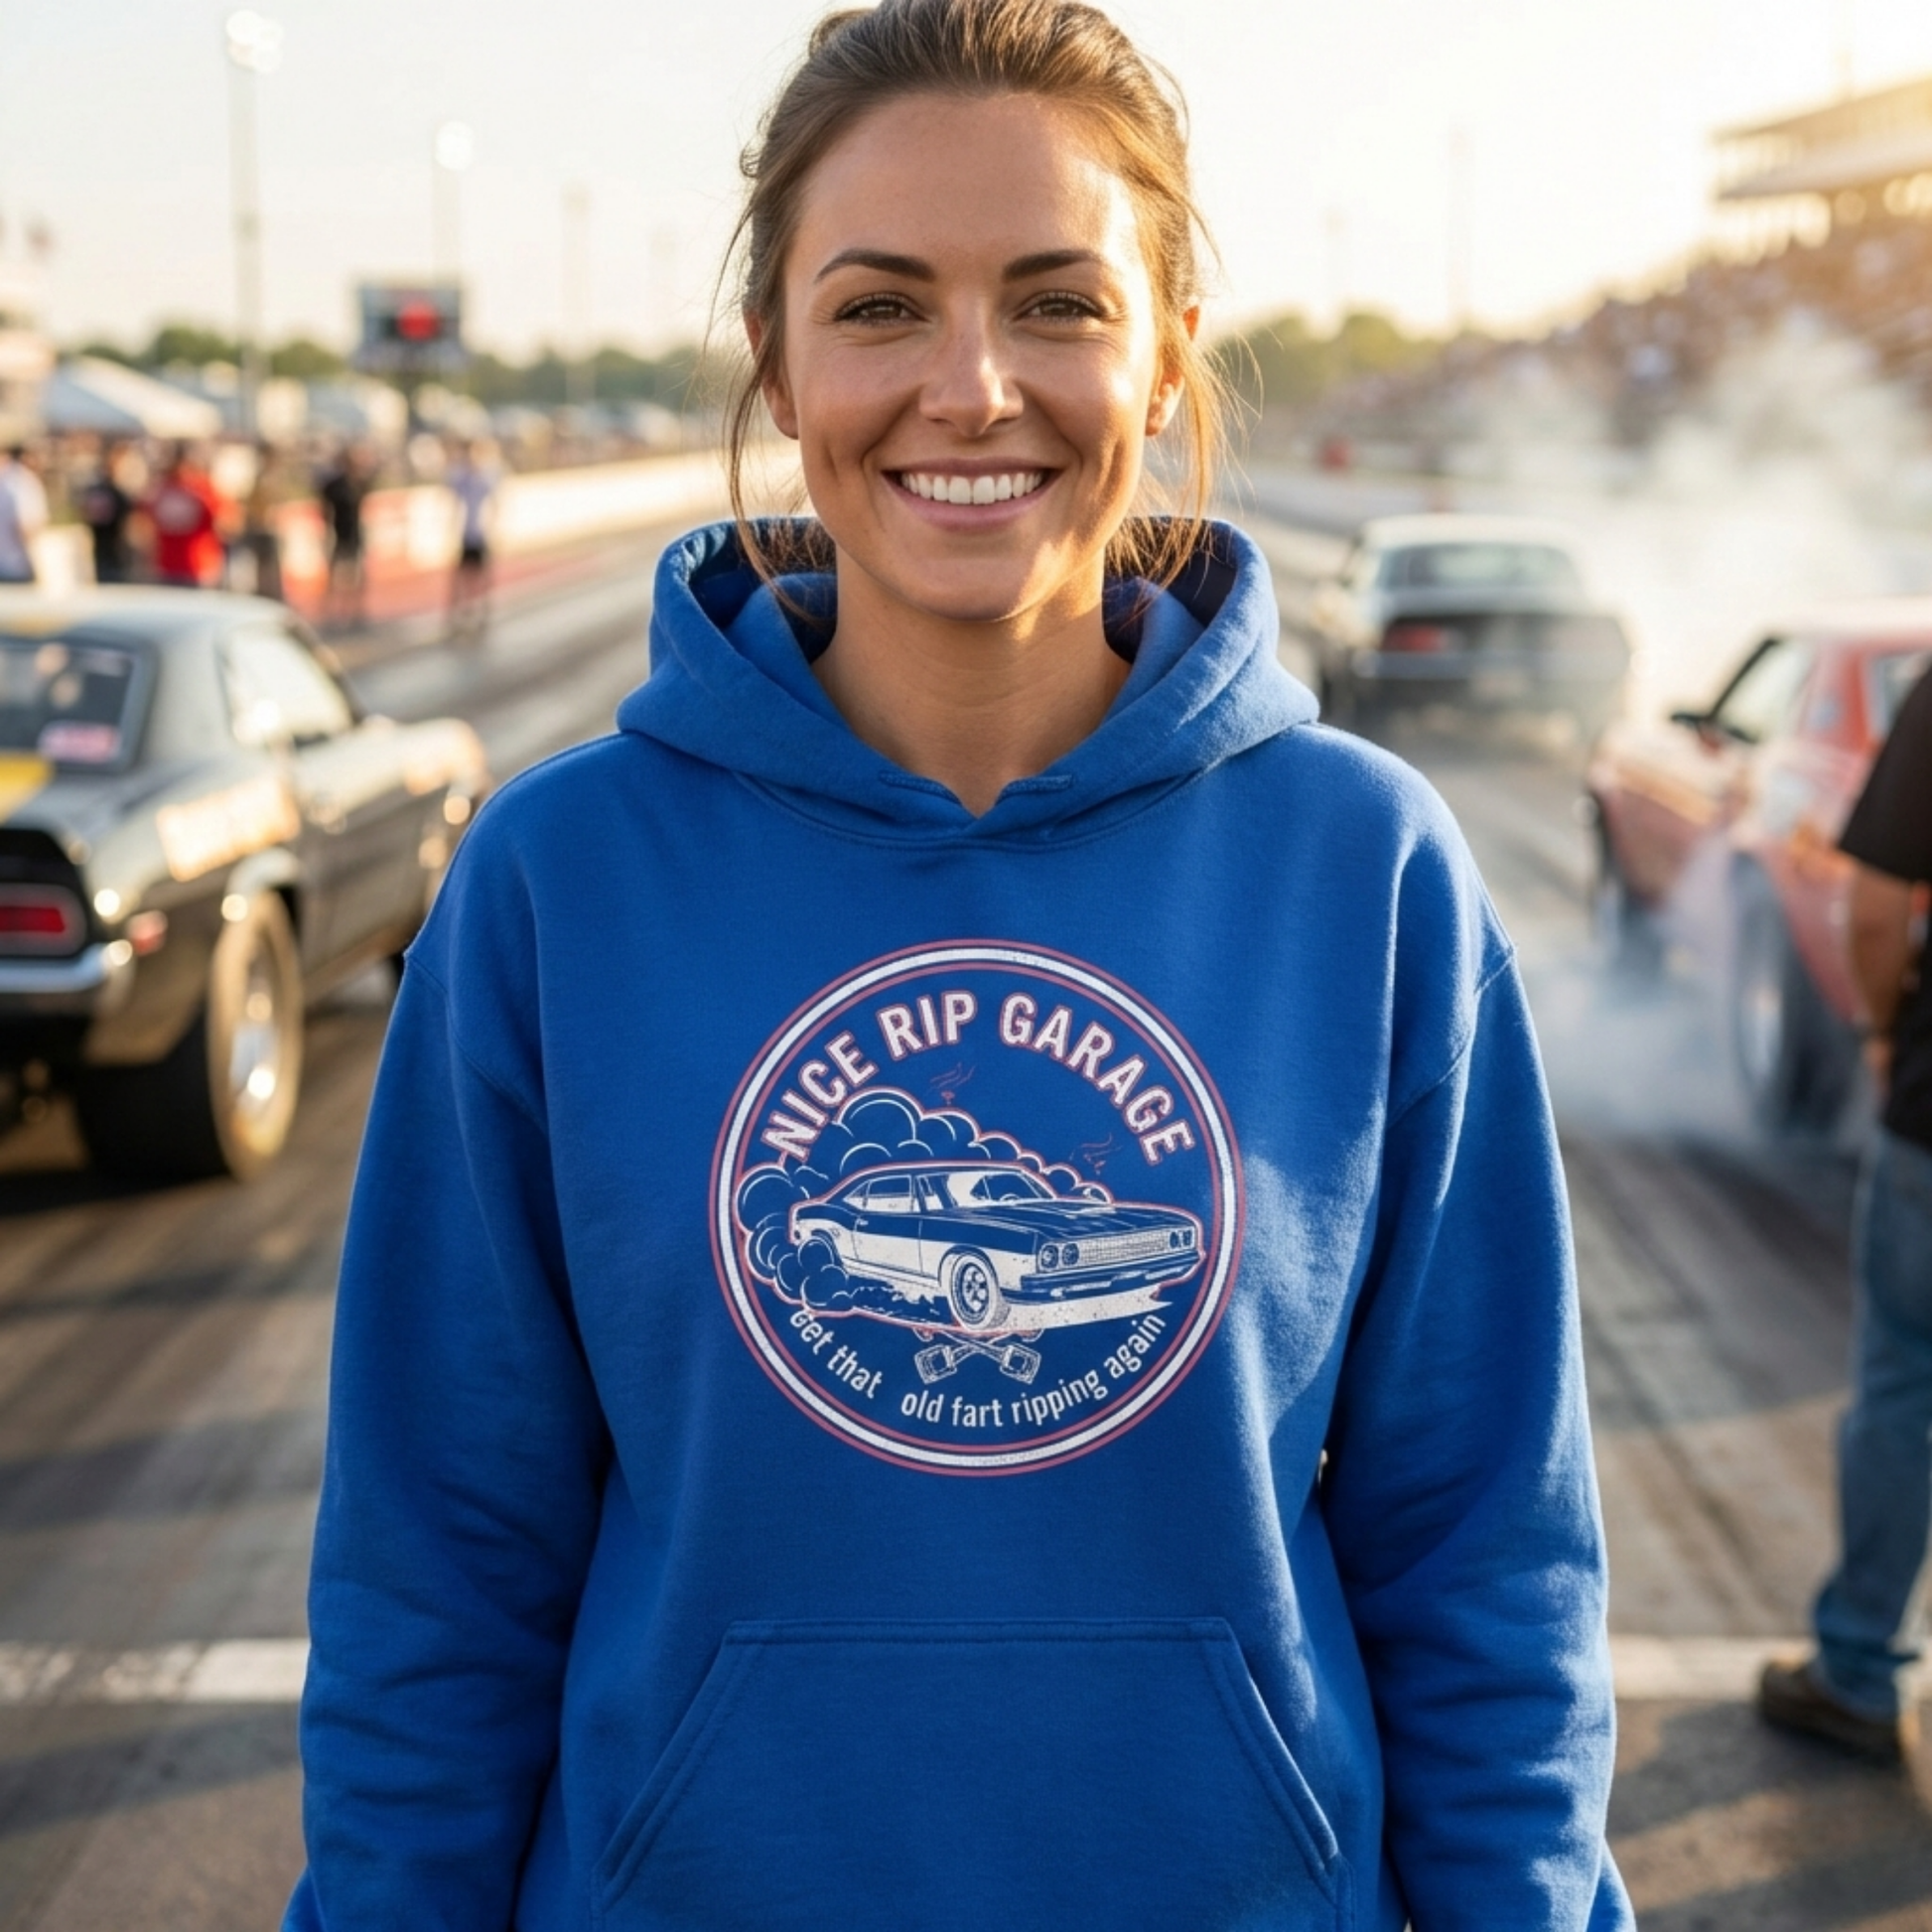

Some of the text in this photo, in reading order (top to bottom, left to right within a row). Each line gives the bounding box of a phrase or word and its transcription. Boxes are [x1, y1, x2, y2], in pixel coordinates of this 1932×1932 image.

[761, 991, 1195, 1166] NICE RIP GARAGE
[827, 1344, 883, 1399] that
[900, 1390, 944, 1423] old
[951, 1396, 1004, 1428] fart
[1011, 1370, 1109, 1425] ripping
[1103, 1314, 1167, 1379] again
